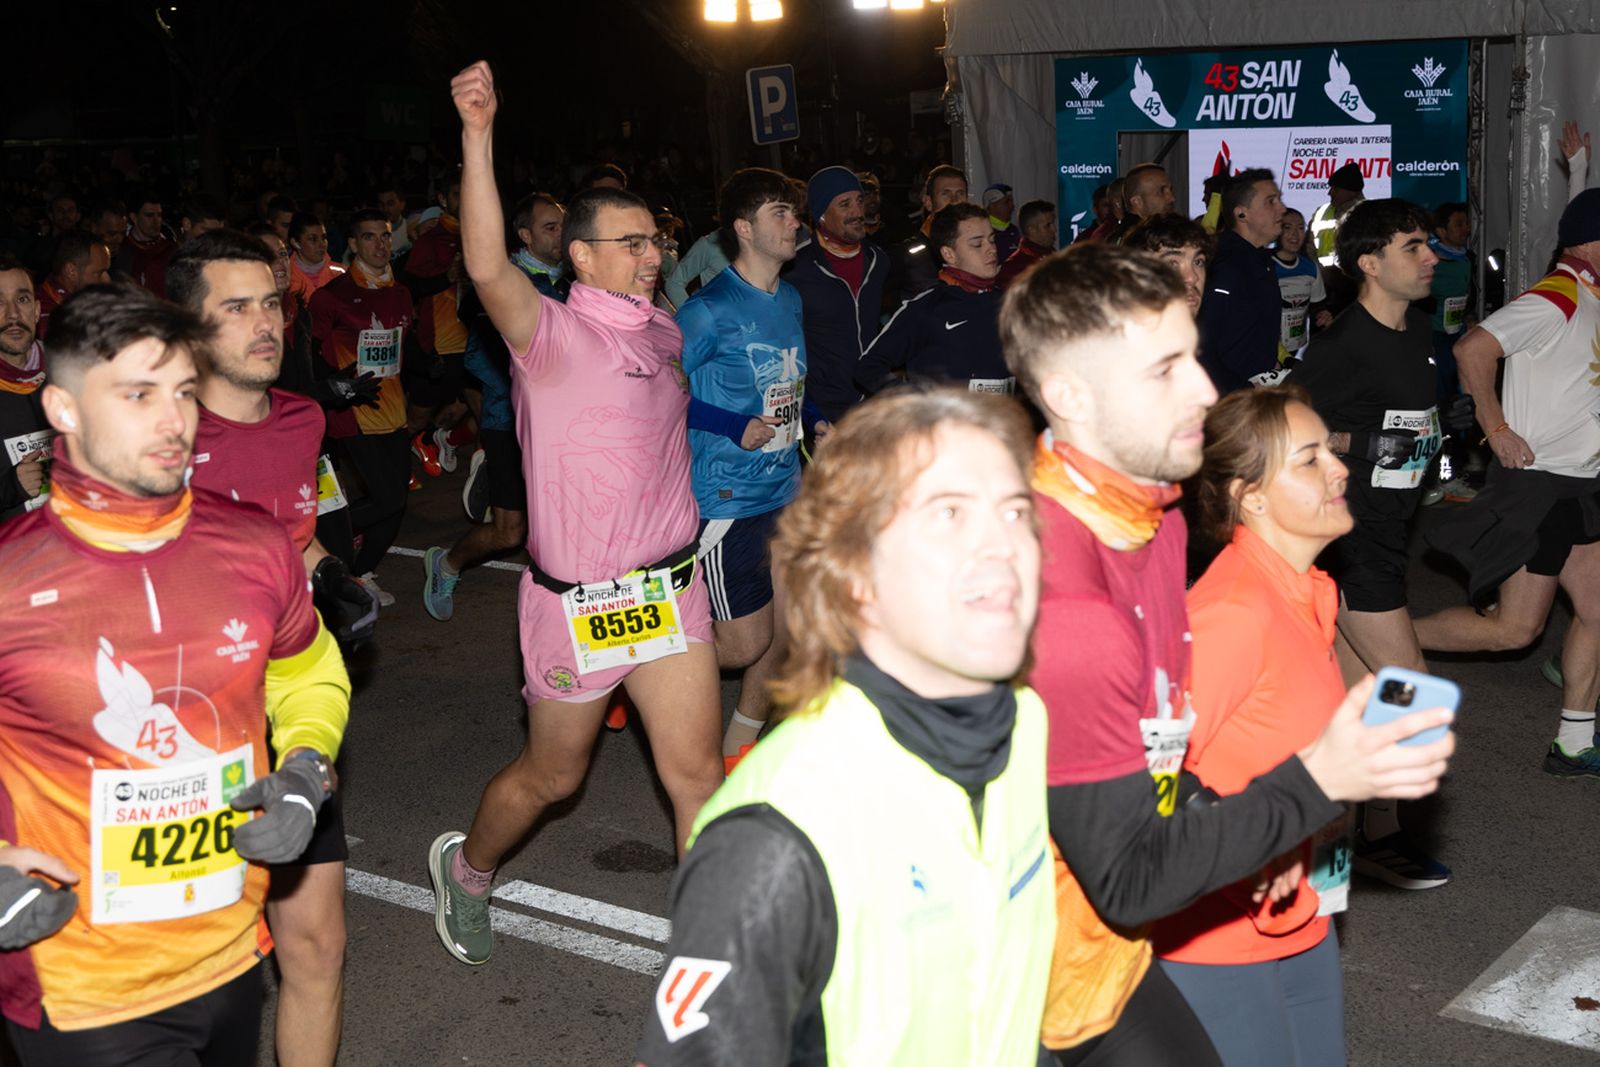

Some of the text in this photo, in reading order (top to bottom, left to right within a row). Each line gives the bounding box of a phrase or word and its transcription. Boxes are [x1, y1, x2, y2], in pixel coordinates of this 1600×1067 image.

[1204, 60, 1302, 91] 43 SAN
[1196, 84, 1296, 122] ANTÓN
[1339, 90, 1359, 111] 43
[1404, 88, 1453, 98] CAJA RURAL
[381, 102, 416, 125] WC
[759, 76, 787, 134] P
[1143, 97, 1161, 116] 43
[1293, 137, 1327, 145] CARRERA
[1328, 137, 1358, 145] URBANA
[1292, 148, 1338, 157] NOCHE DE
[1060, 163, 1112, 174] calderón
[1288, 158, 1337, 179] SAN
[1396, 160, 1460, 172] calderón
[1295, 182, 1305, 190] DE
[587, 588, 619, 602] NOCHE
[621, 586, 632, 595] DE
[578, 603, 598, 616] SAN
[589, 603, 661, 641] 8553
[135, 719, 178, 759] 43
[137, 784, 189, 802] NOCHE
[191, 777, 208, 793] DE
[115, 807, 151, 823] SAN
[131, 810, 235, 868] 4226
